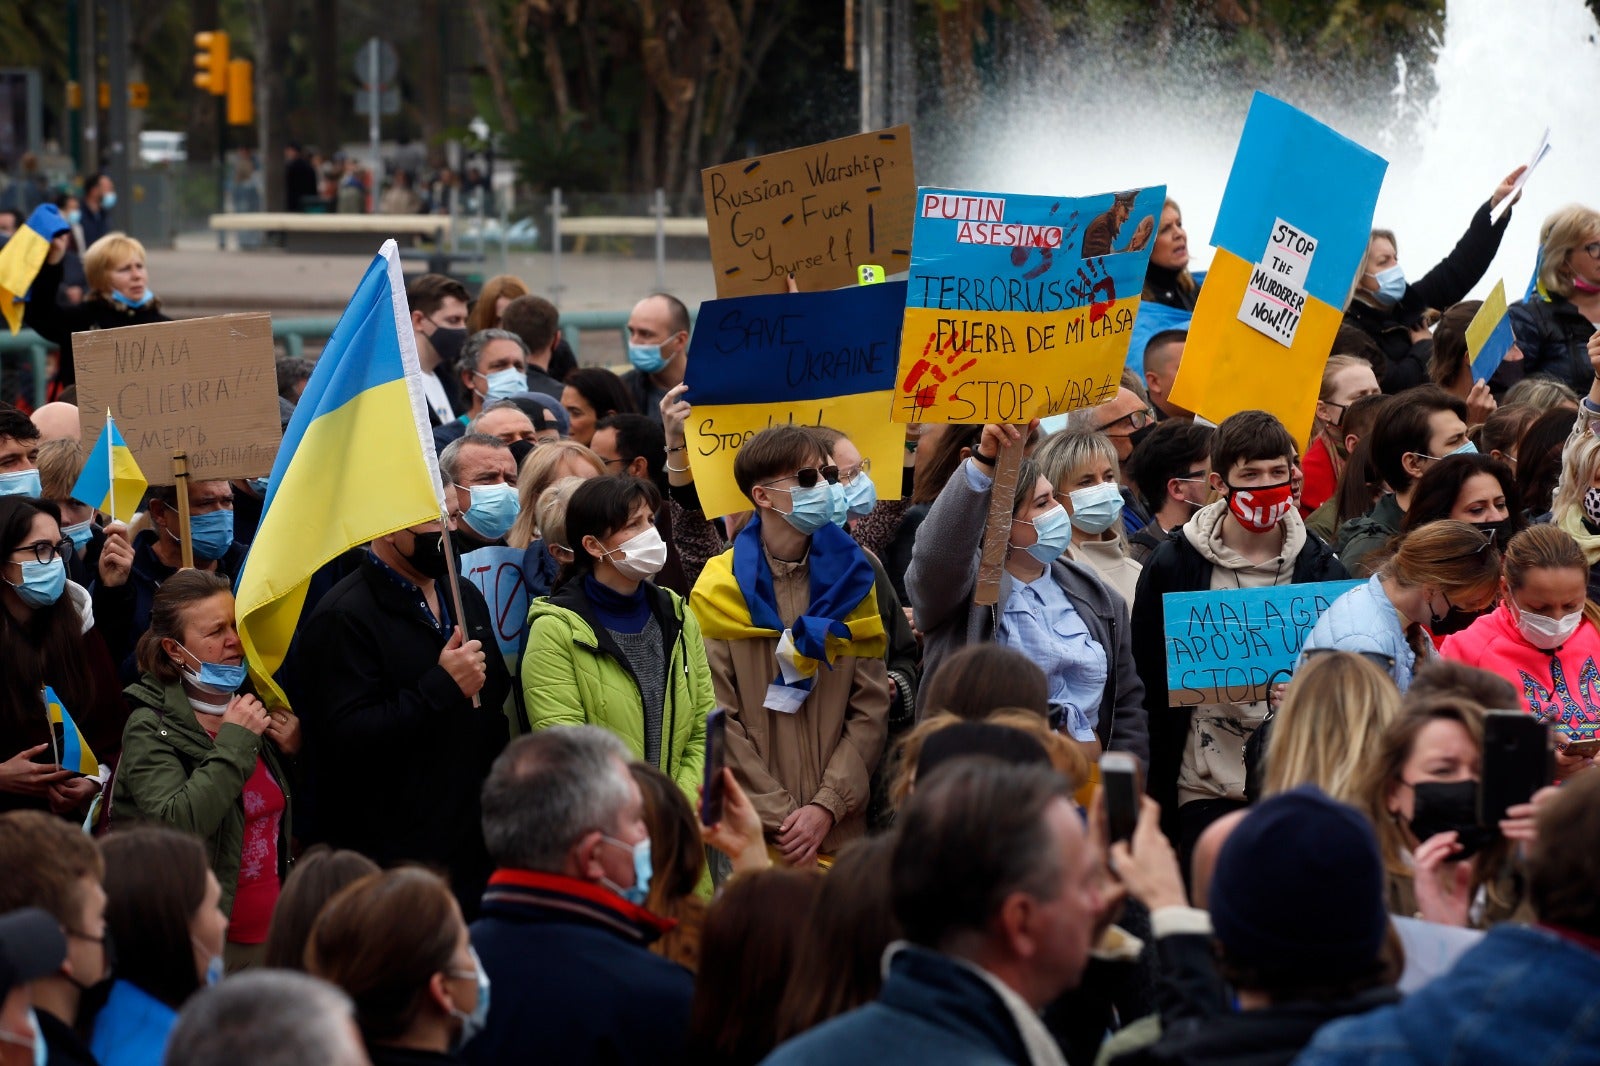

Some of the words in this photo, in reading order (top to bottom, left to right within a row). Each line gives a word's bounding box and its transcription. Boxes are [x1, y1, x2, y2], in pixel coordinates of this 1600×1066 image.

[711, 173, 795, 216] Russian
[924, 195, 1004, 221] PUTIN
[731, 211, 765, 247] Go
[957, 222, 1063, 248] ASESINO
[1273, 224, 1314, 256] STOP
[752, 228, 853, 281] Yourself
[1273, 256, 1293, 275] THE
[1250, 269, 1304, 313] MURDERER
[715, 309, 805, 355] SAVE
[934, 318, 1017, 354] FUERA
[1027, 325, 1056, 353] DE
[1091, 309, 1133, 338] CASA
[1251, 302, 1299, 338] NOW!!!
[152, 341, 165, 369] A
[170, 338, 191, 365] LA
[1173, 631, 1272, 664] APOYA
[1181, 667, 1269, 705] STOP
